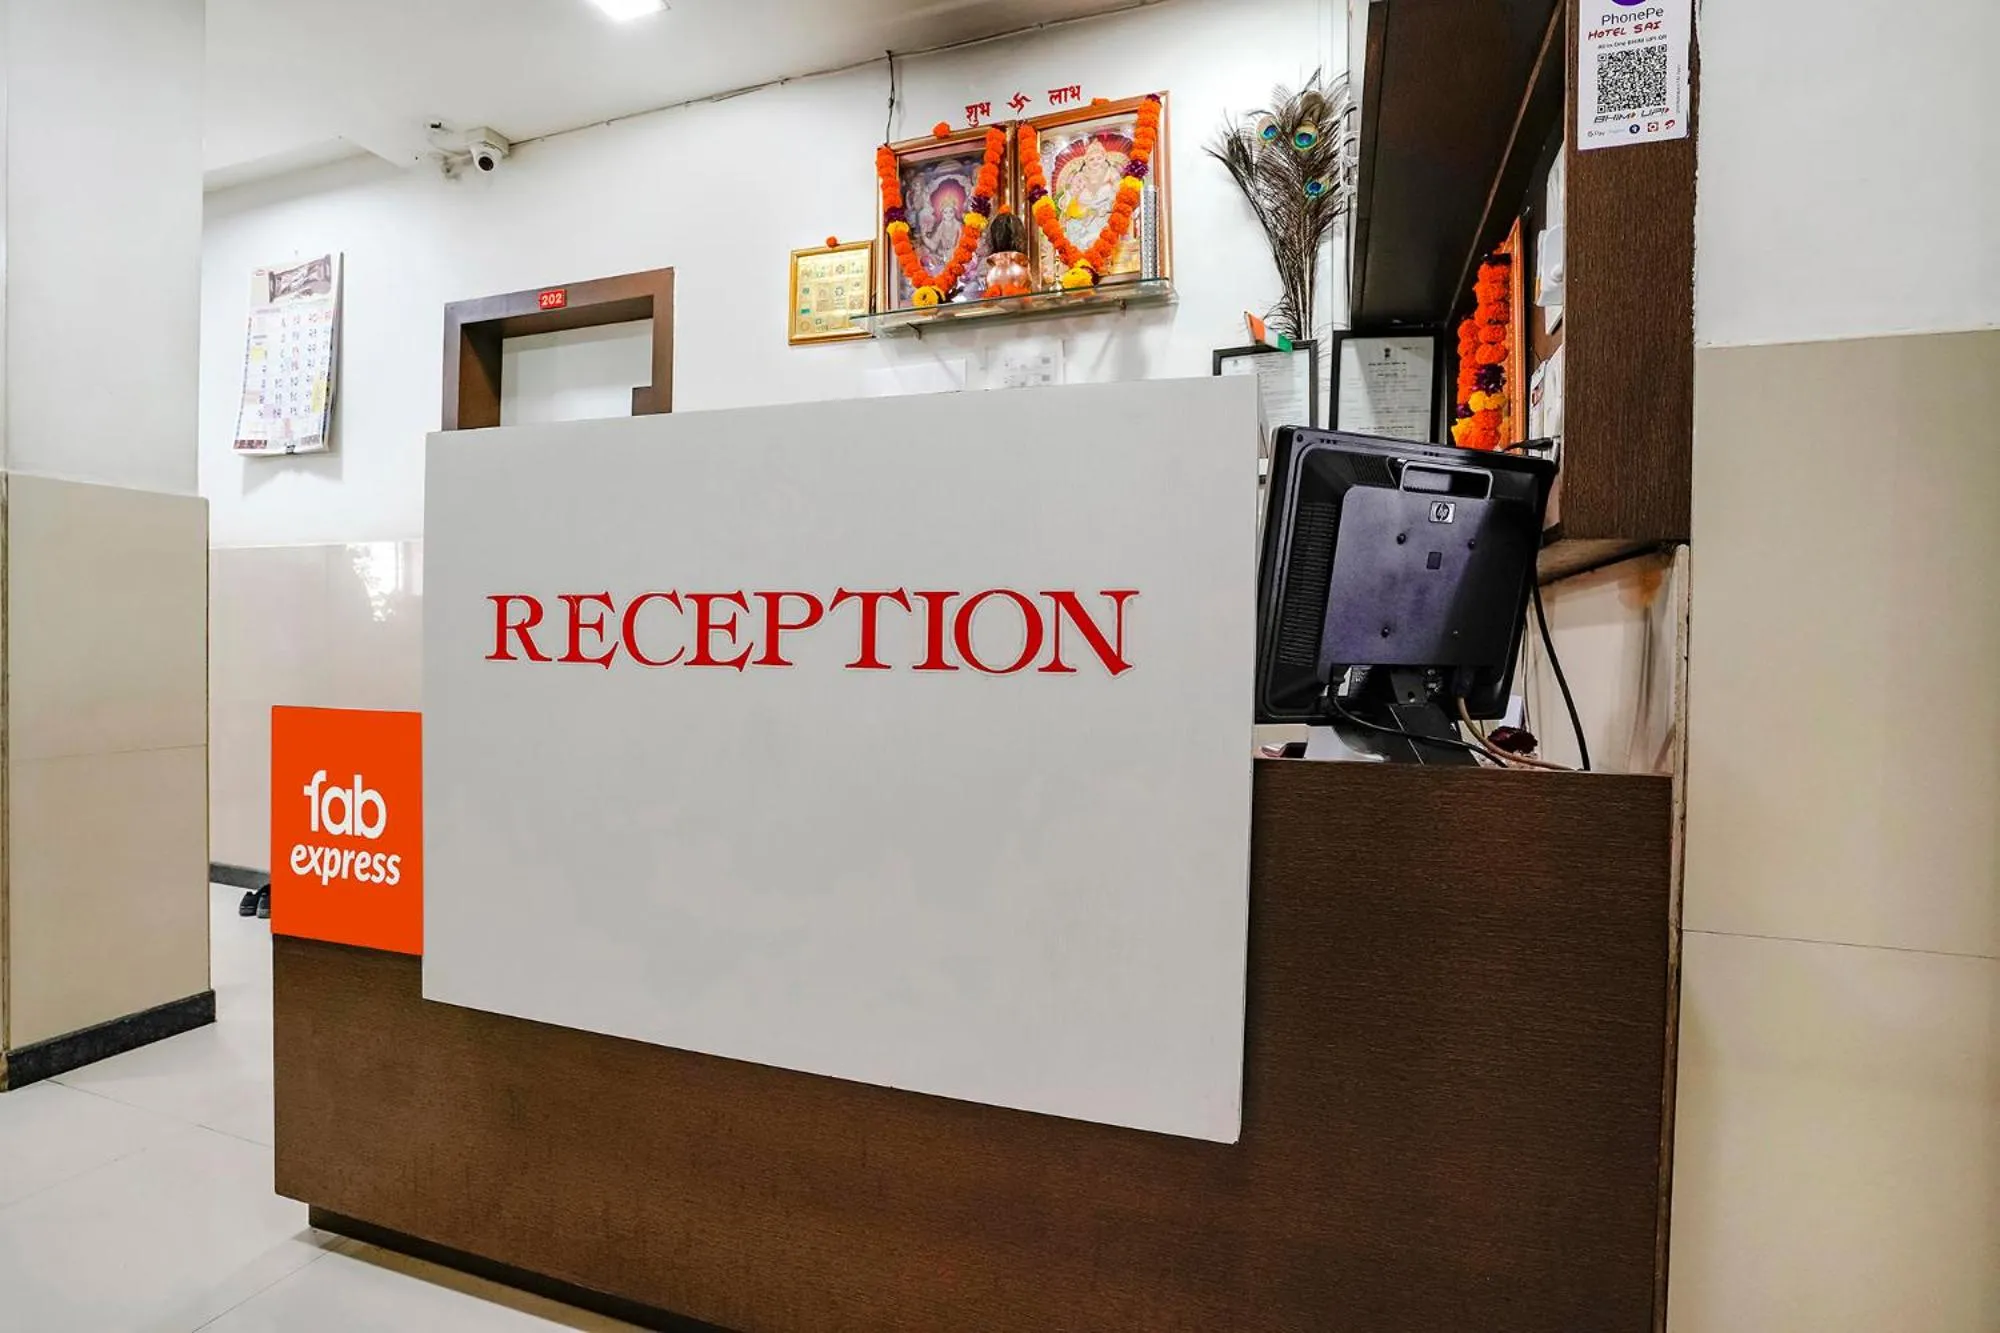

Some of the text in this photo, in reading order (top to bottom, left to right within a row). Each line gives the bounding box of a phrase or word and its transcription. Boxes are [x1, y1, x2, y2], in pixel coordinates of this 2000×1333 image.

[1587, 20, 1662, 40] HOTEL SAI
[1601, 7, 1664, 26] PhonePe
[965, 85, 1081, 128] शुभ लाभ
[542, 292, 562, 306] 202
[485, 587, 1139, 677] RECEPTION
[303, 769, 388, 840] fab
[290, 843, 402, 886] express
